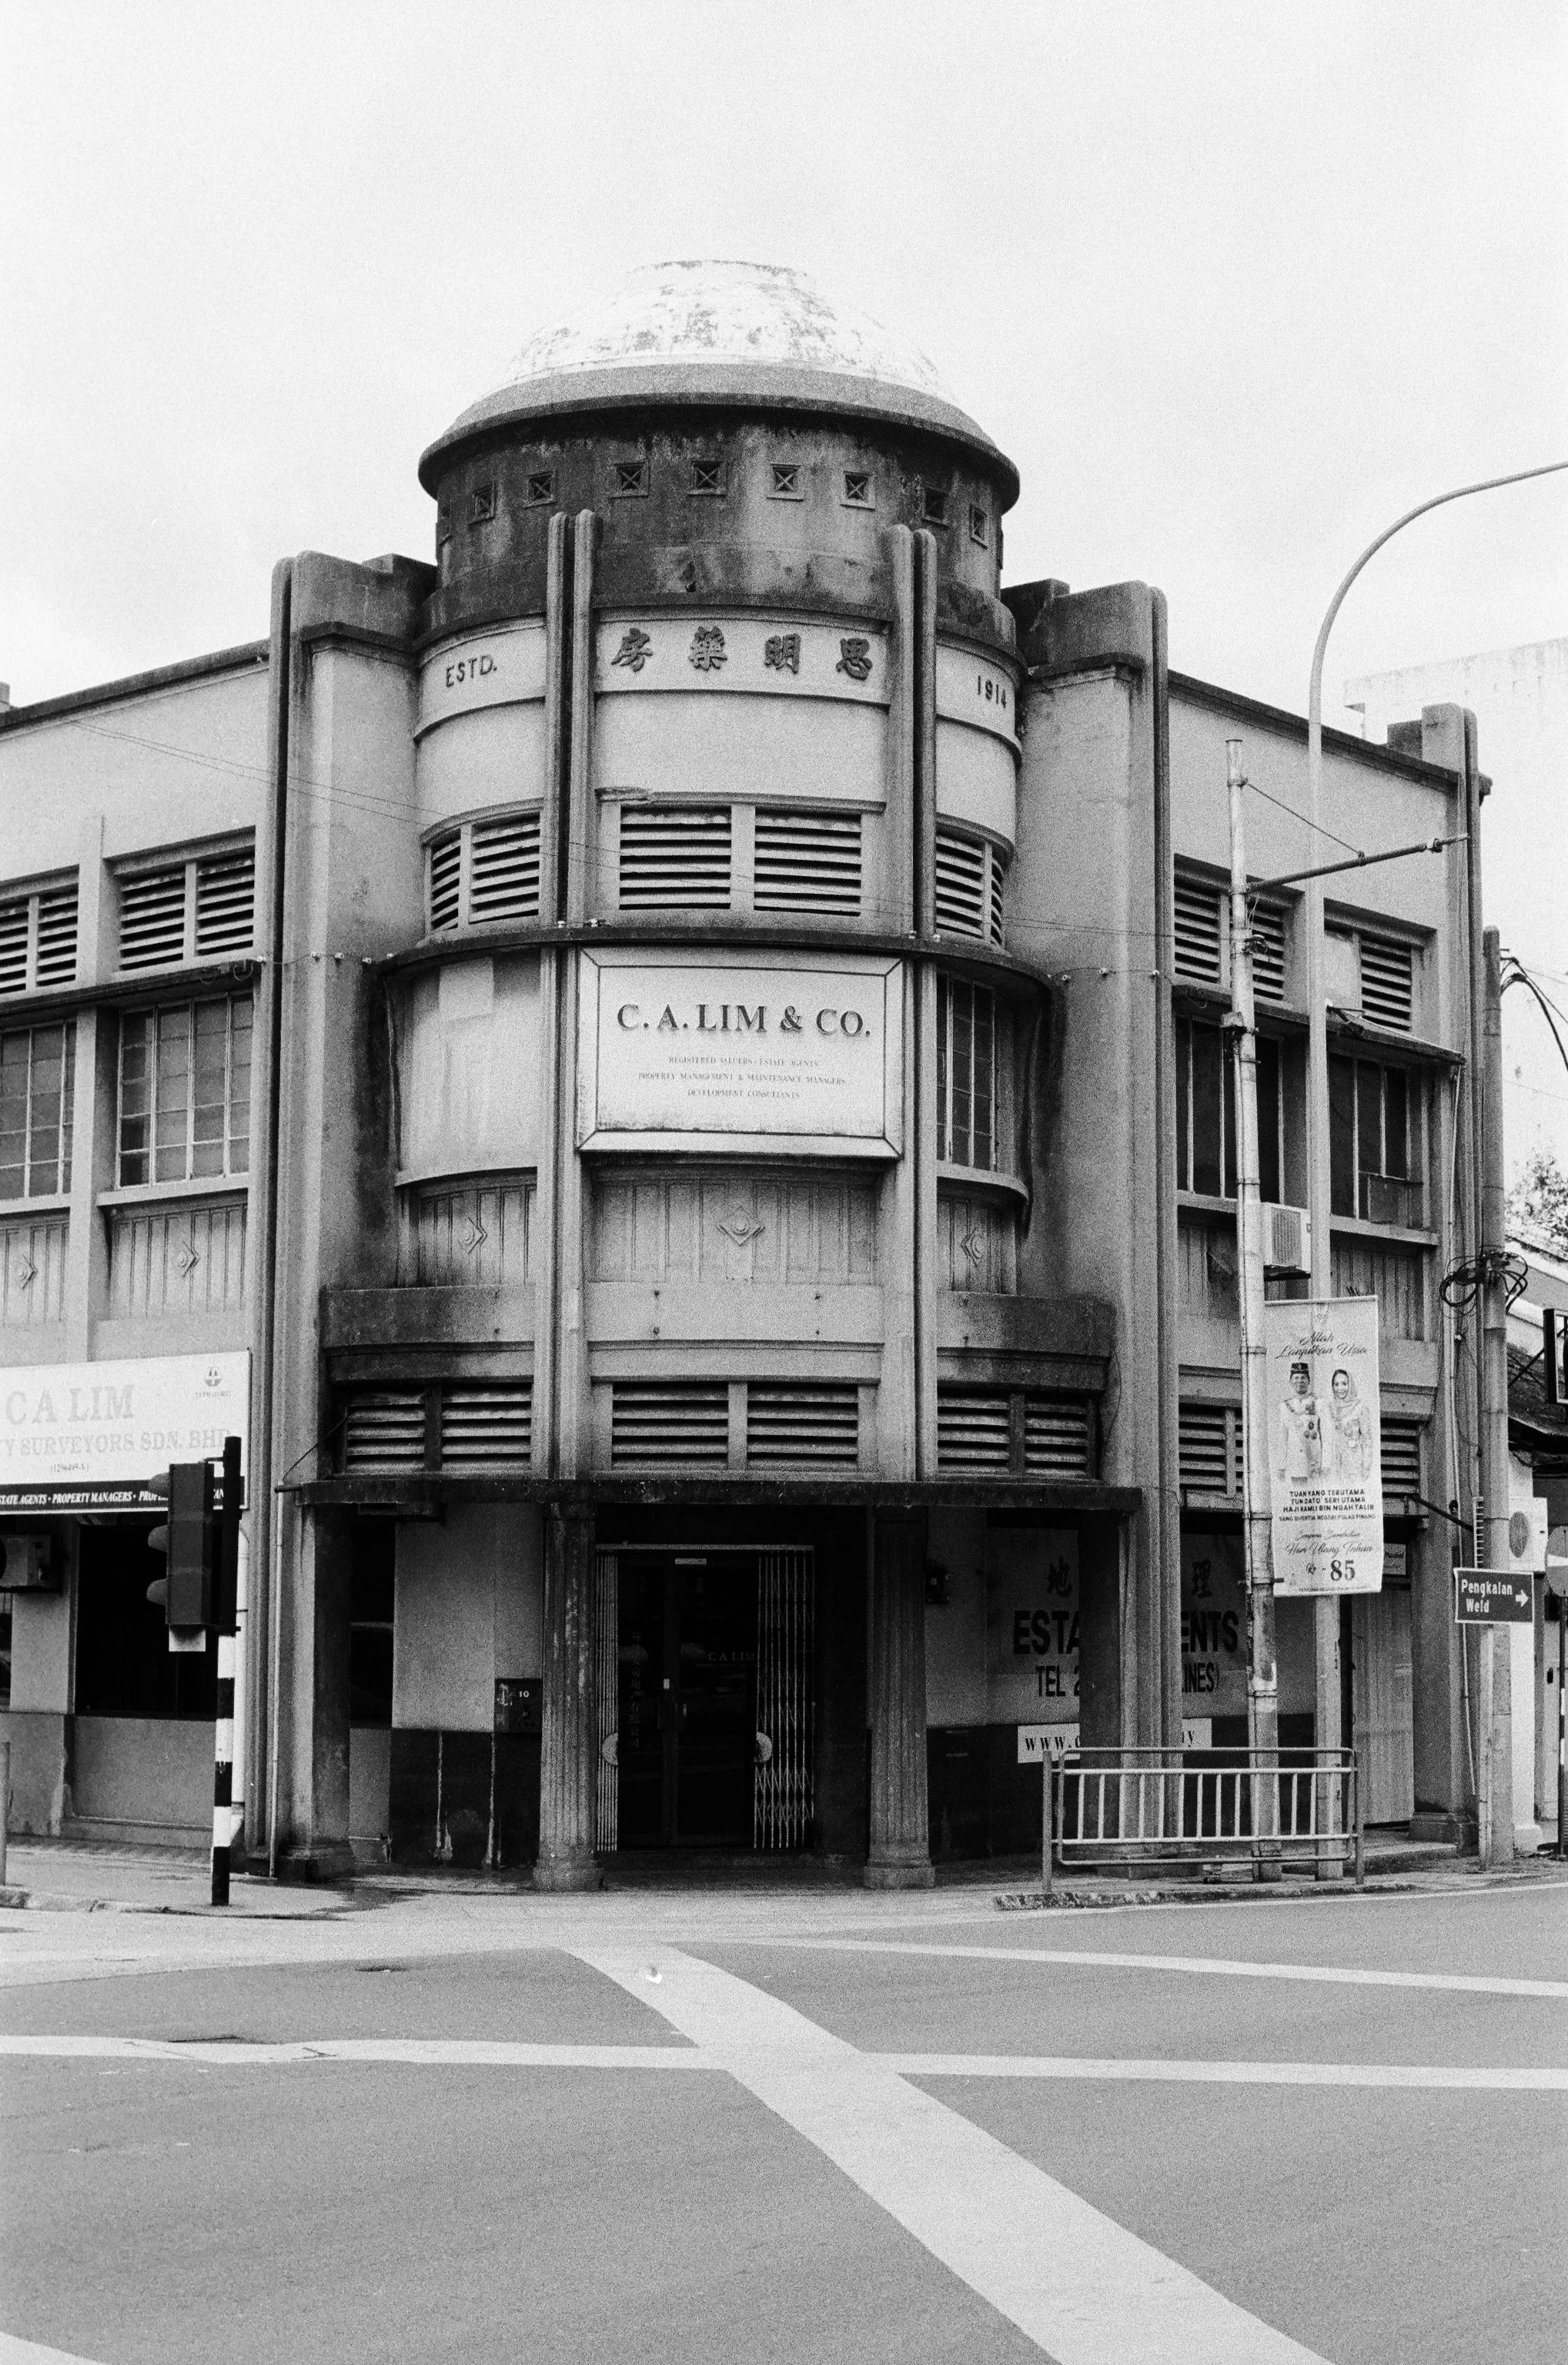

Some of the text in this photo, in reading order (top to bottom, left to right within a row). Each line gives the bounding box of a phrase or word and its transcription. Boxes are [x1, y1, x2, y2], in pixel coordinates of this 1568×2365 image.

[446, 654, 497, 687] ESTD.
[977, 675, 1007, 709] 1914
[780, 1005, 803, 1032] &
[816, 1009, 871, 1037] CO.
[668, 1056, 717, 1065] REGISTERED
[638, 1072, 675, 1081] PROPERTY
[680, 1072, 734, 1082] MANAGEMENT
[747, 1074, 801, 1083] MAINTENANCE
[806, 1076, 846, 1085] MANAGERS
[687, 1089, 801, 1099] DEVELOPMENT CONSULTANTS
[20, 1433, 135, 1456] SURVEYORS
[19, 1494, 48, 1505] AGENTS
[52, 1492, 90, 1504] PROPERTY
[90, 1490, 132, 1503] MANAGERS
[1329, 1559, 1356, 1582] 85
[1461, 1578, 1513, 1598] Pengkalan
[1466, 1598, 1490, 1614] Weld
[1035, 1665, 1066, 1698] TEL
